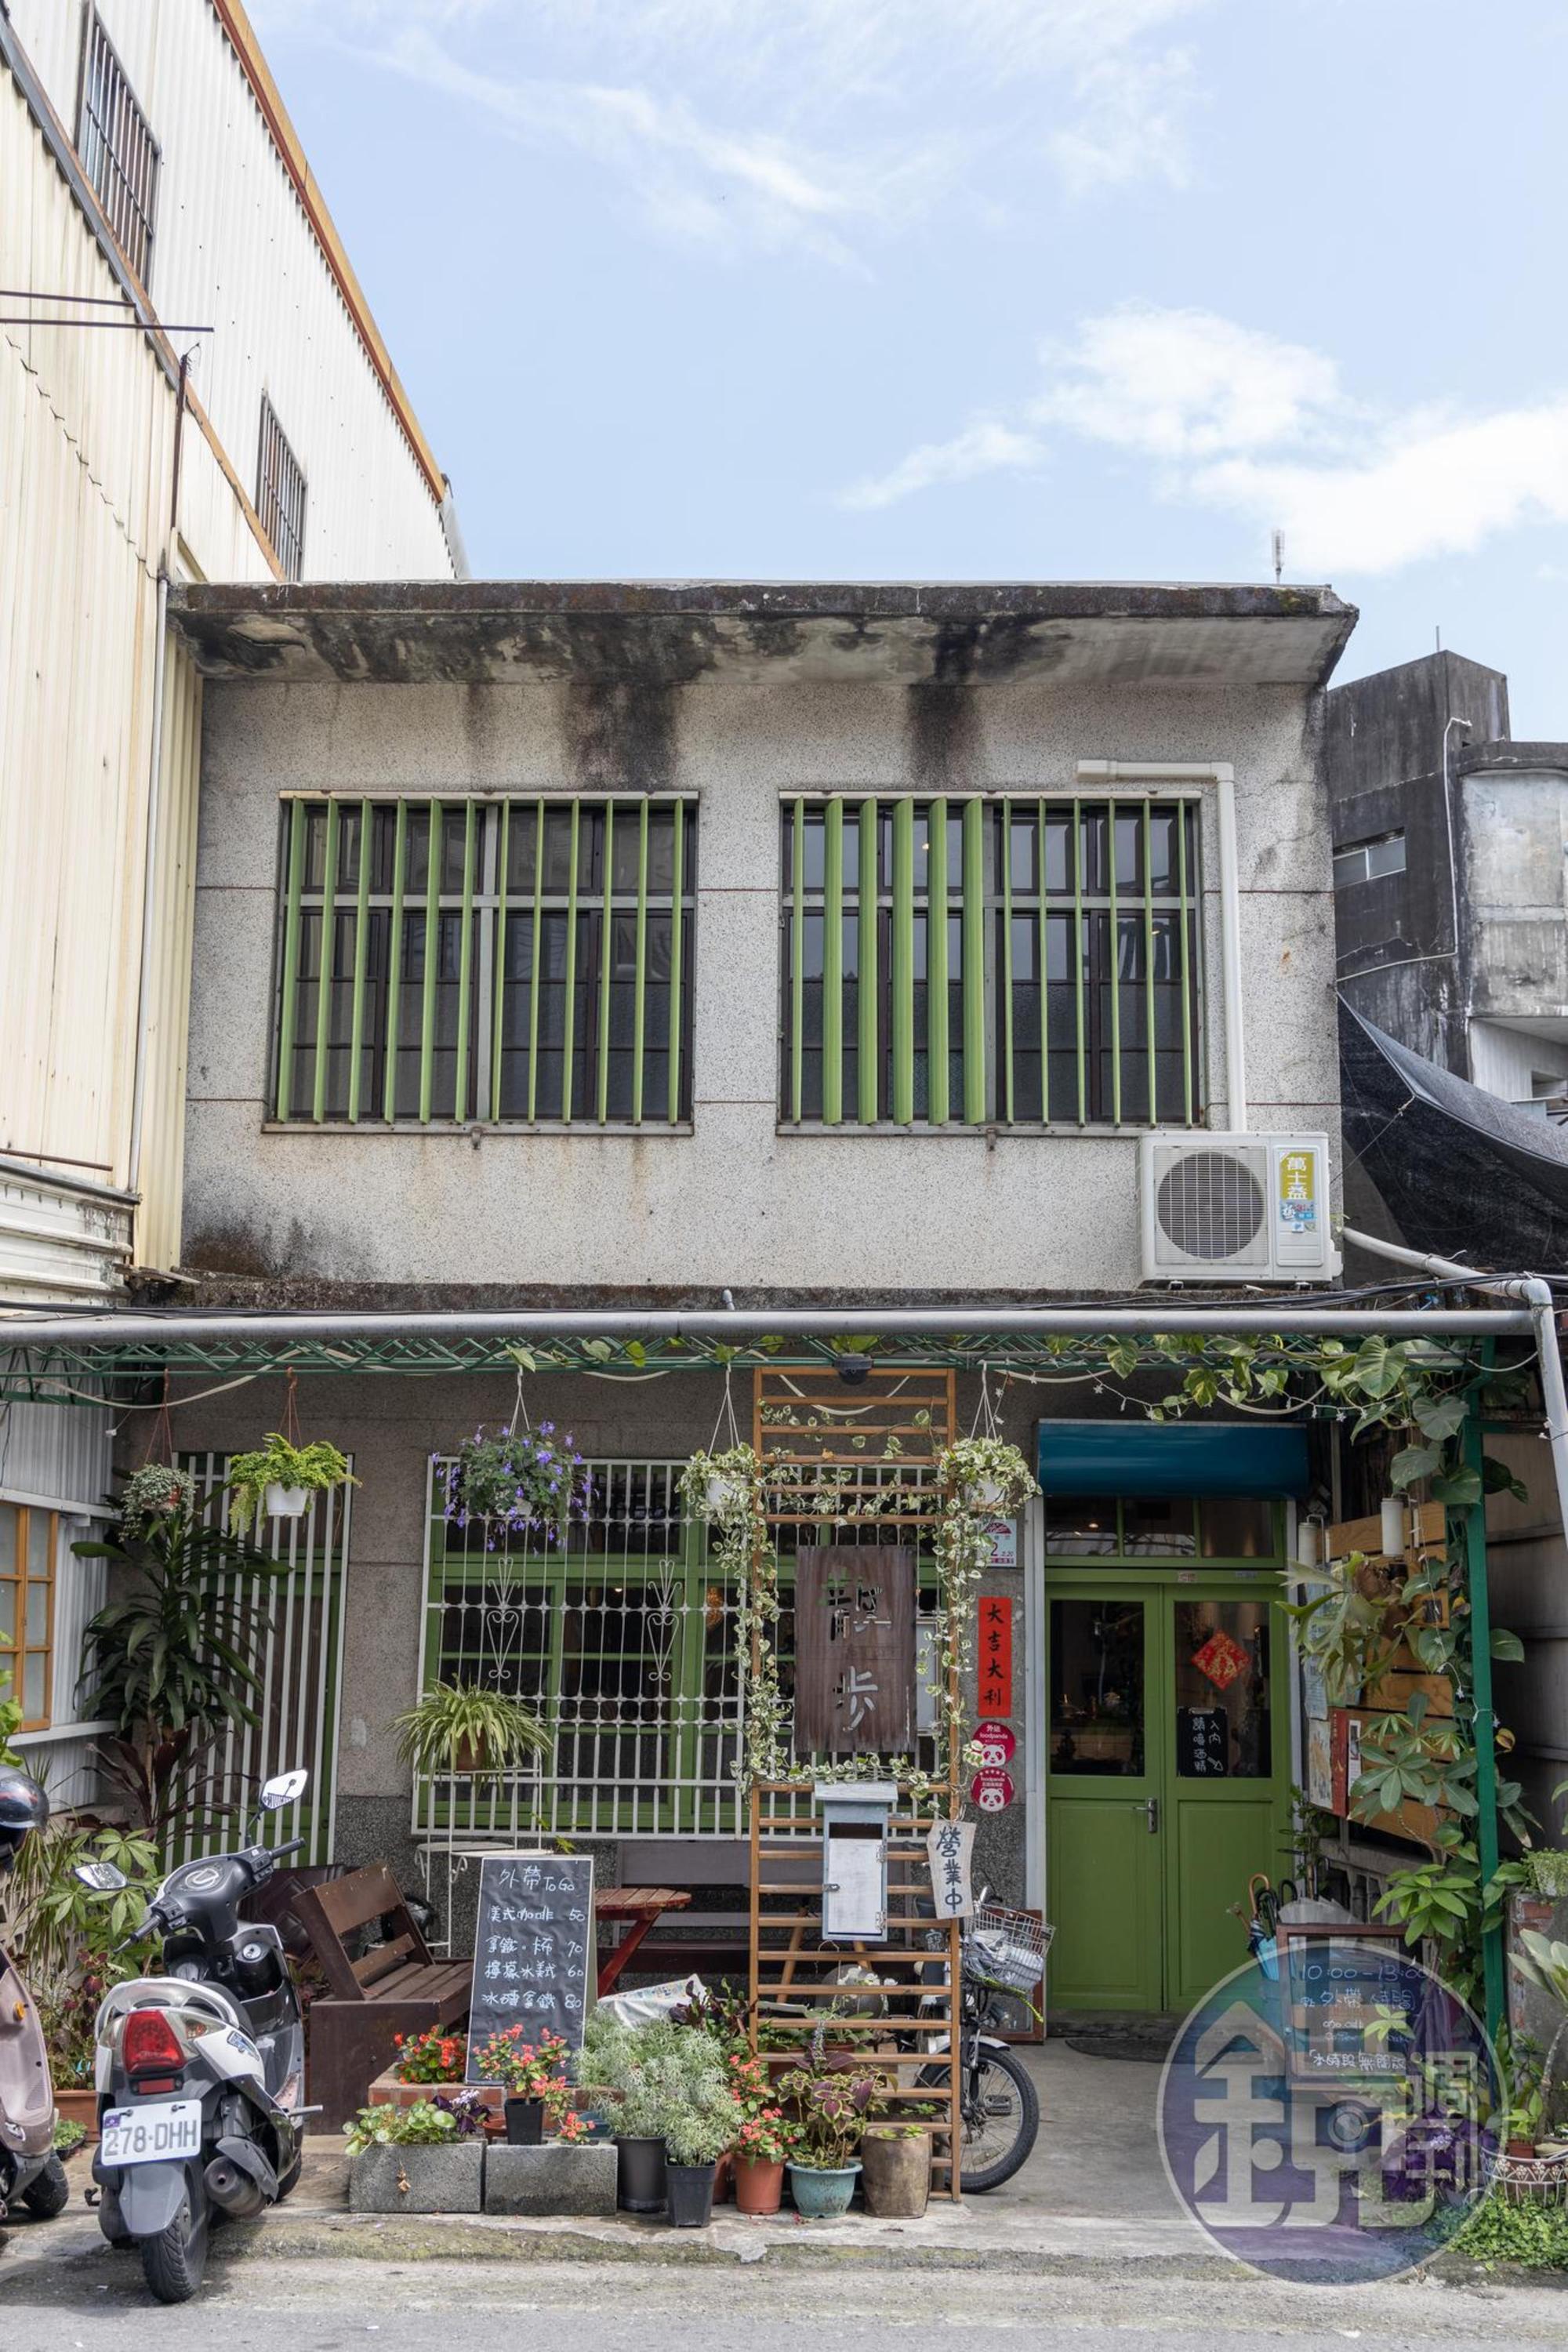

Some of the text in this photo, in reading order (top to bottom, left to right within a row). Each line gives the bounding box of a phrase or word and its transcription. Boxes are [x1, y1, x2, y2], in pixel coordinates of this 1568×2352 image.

[985, 1603, 1004, 1707] 大吉大利
[499, 1865, 541, 1889] 外帶
[936, 1826, 963, 1915] 營業中
[489, 1905, 585, 1922] 美式咖啡 50
[567, 1940, 583, 1958] 70
[567, 1965, 583, 1977] 60
[564, 1994, 582, 2009] 80
